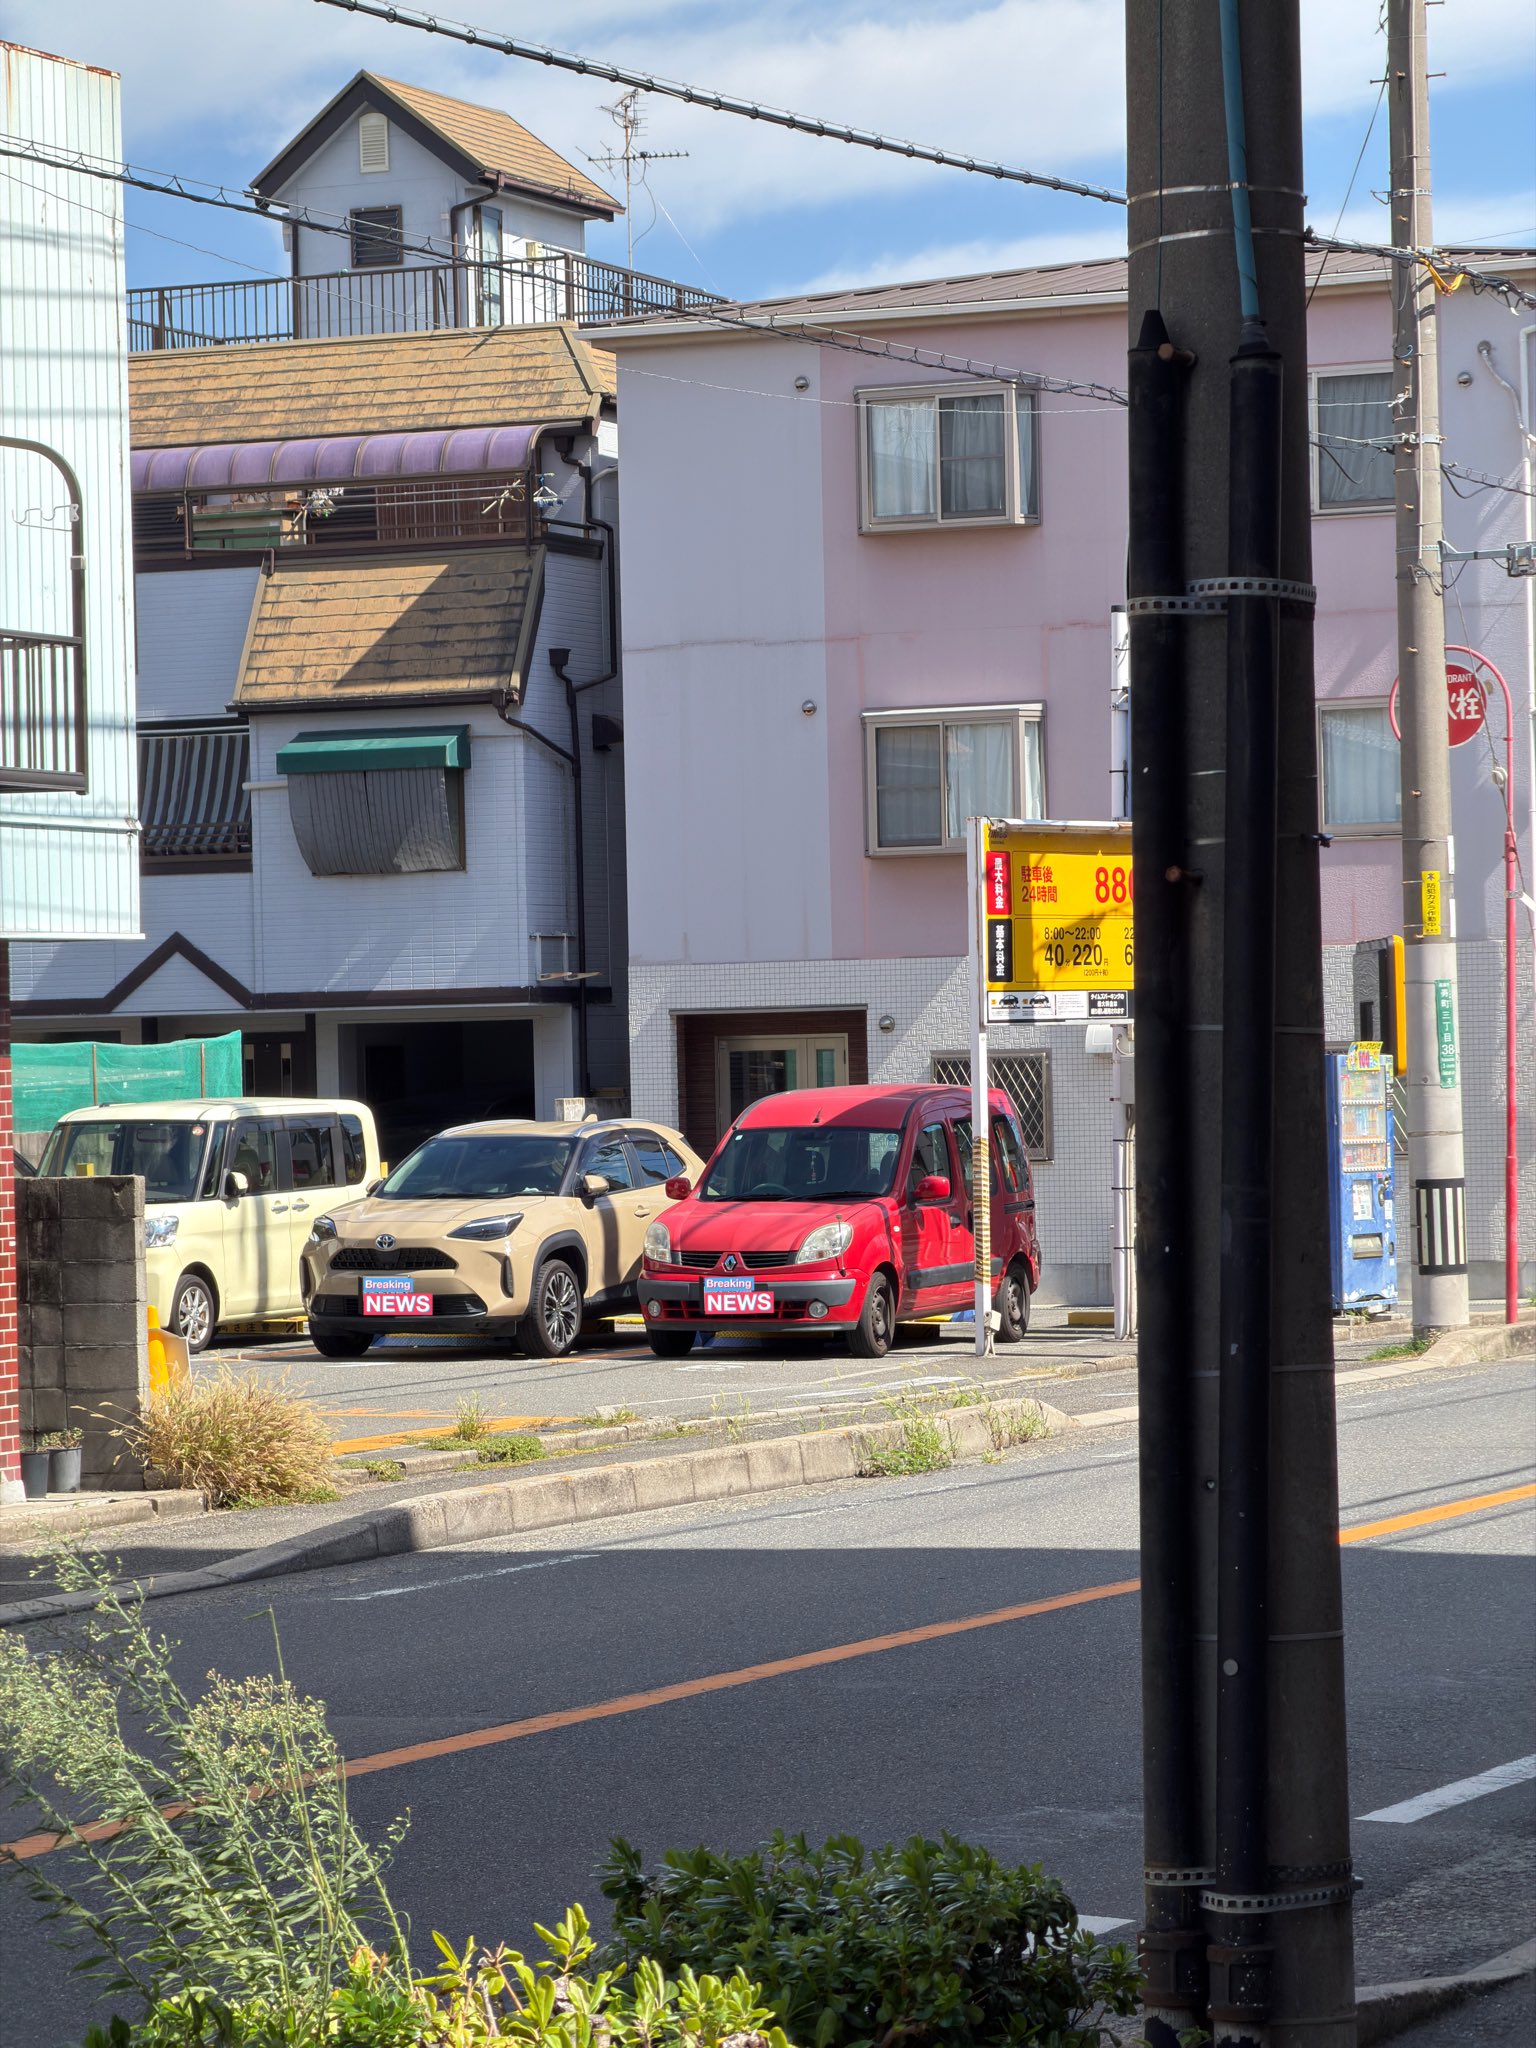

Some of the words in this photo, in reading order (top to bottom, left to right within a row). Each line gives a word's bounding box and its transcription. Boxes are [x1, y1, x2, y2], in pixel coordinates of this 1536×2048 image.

[994, 857, 1004, 909] 最大料金
[1021, 865, 1053, 883] 駐車後
[1021, 885, 1058, 903] 24時間
[995, 925, 1005, 976] 基本料金
[1441, 1044, 1455, 1055] 38
